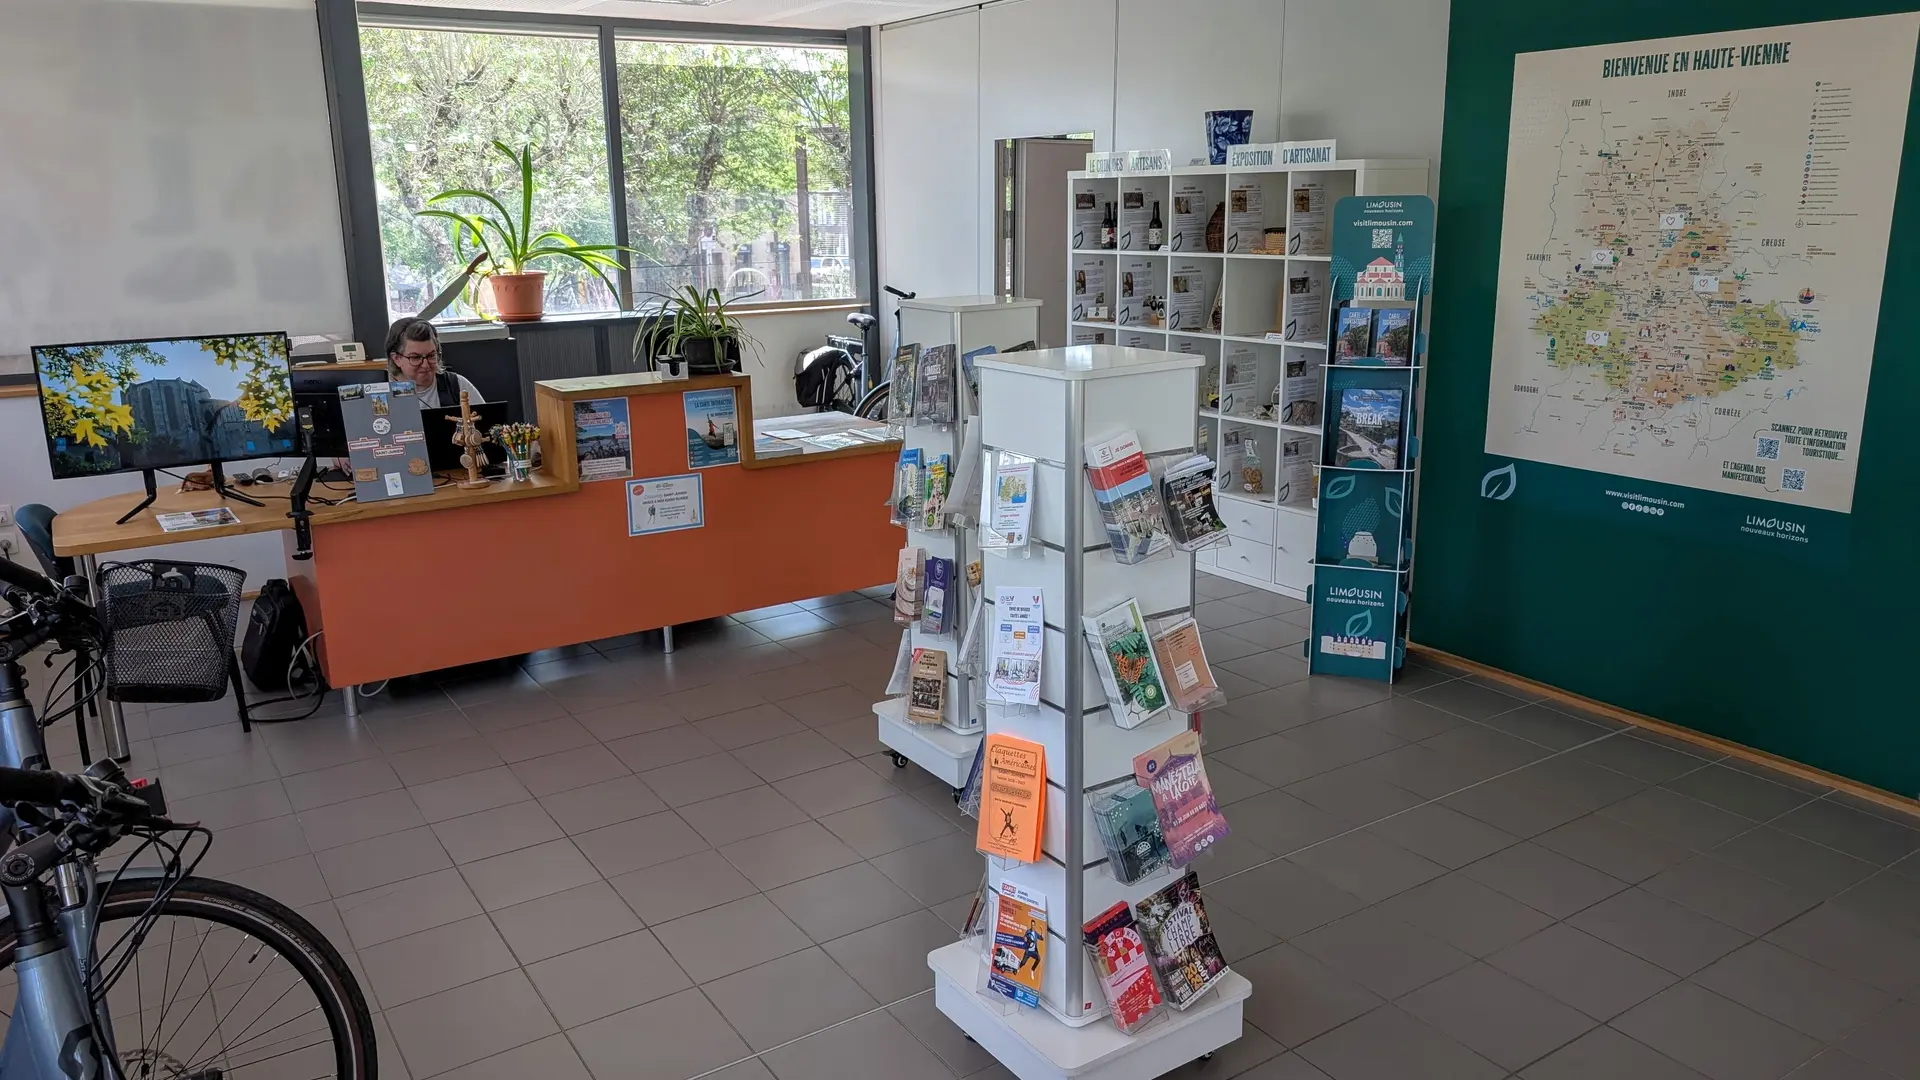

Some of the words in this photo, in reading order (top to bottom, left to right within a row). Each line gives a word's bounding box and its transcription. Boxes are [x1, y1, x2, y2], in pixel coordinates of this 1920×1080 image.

[1602, 53, 1670, 79] BIENVENUE
[1672, 51, 1690, 73] EN
[1693, 42, 1792, 71] HAUTE-VIENNE
[1667, 88, 1687, 98] INDRE
[1571, 98, 1592, 108] VIENNE
[1232, 150, 1273, 167] EXPOSITION
[1282, 146, 1332, 165] D'ARTISANAT
[1089, 159, 1096, 173] LE
[1130, 156, 1163, 171] ARTISANS
[1365, 201, 1403, 209] LIMOUSIN
[1353, 219, 1413, 228] visitlimousin.com
[1761, 238, 1786, 248] CREUSE
[1526, 253, 1552, 262] CHARENTE
[1513, 384, 1540, 394] DORDOGNE
[1355, 412, 1384, 426] BREAK
[1714, 407, 1741, 418] CORRÈZE
[1771, 423, 1796, 435] SCANNEZ
[1797, 426, 1814, 436] POUR
[1814, 427, 1848, 441] RETROUVER
[1784, 434, 1802, 445] TOUTE
[1802, 436, 1846, 451] L'INFORMATION
[1722, 460, 1729, 469] ET
[1729, 461, 1754, 473] L'AGENDA
[1755, 464, 1766, 475] DES
[1721, 470, 1767, 485] MANIFESTATIONS
[1605, 488, 1685, 509] www.visitlimousin.com
[1746, 514, 1806, 534] LIMOUSIN
[1740, 526, 1775, 537] nouveaux
[1776, 531, 1809, 543] horizons
[1329, 586, 1383, 599] LIMOUSIN
[1326, 596, 1357, 605] nouveaux
[1357, 598, 1385, 607] horizons
[991, 744, 1027, 760] Claquettes
[203, 896, 245, 911] SCHWALBE
[1163, 906, 1193, 934] FESTIVAL
[1166, 915, 1192, 941] CHAMP
[273, 923, 297, 940] ACTIVE
[295, 937, 311, 953] PLUS
[1169, 928, 1197, 953] LIBRE
